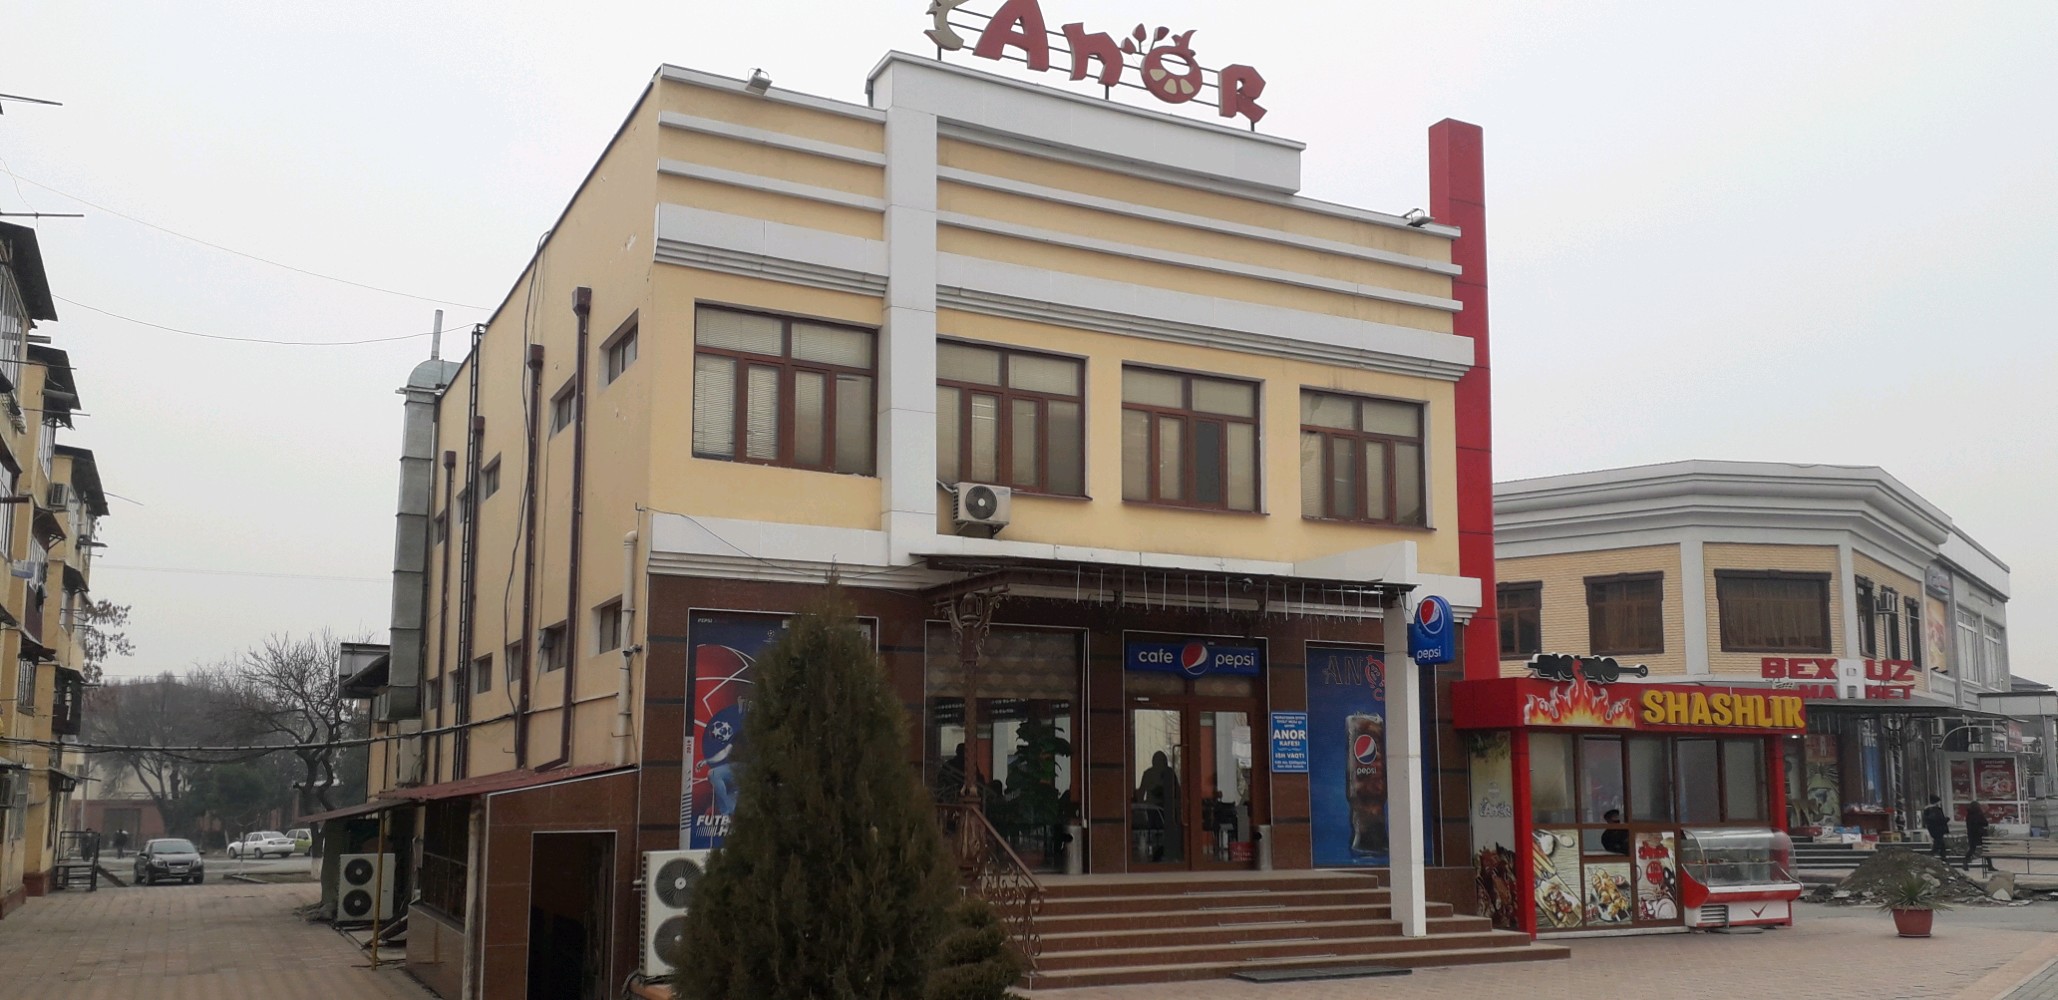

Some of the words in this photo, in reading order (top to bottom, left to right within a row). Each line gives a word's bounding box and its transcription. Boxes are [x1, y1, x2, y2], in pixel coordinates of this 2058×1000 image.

[1138, 648, 1173, 663] cafe
[1215, 652, 1254, 668] pepsi
[1417, 645, 1441, 661] pepsi
[1273, 730, 1306, 740] ANOR
[1356, 766, 1376, 775] pepsi
